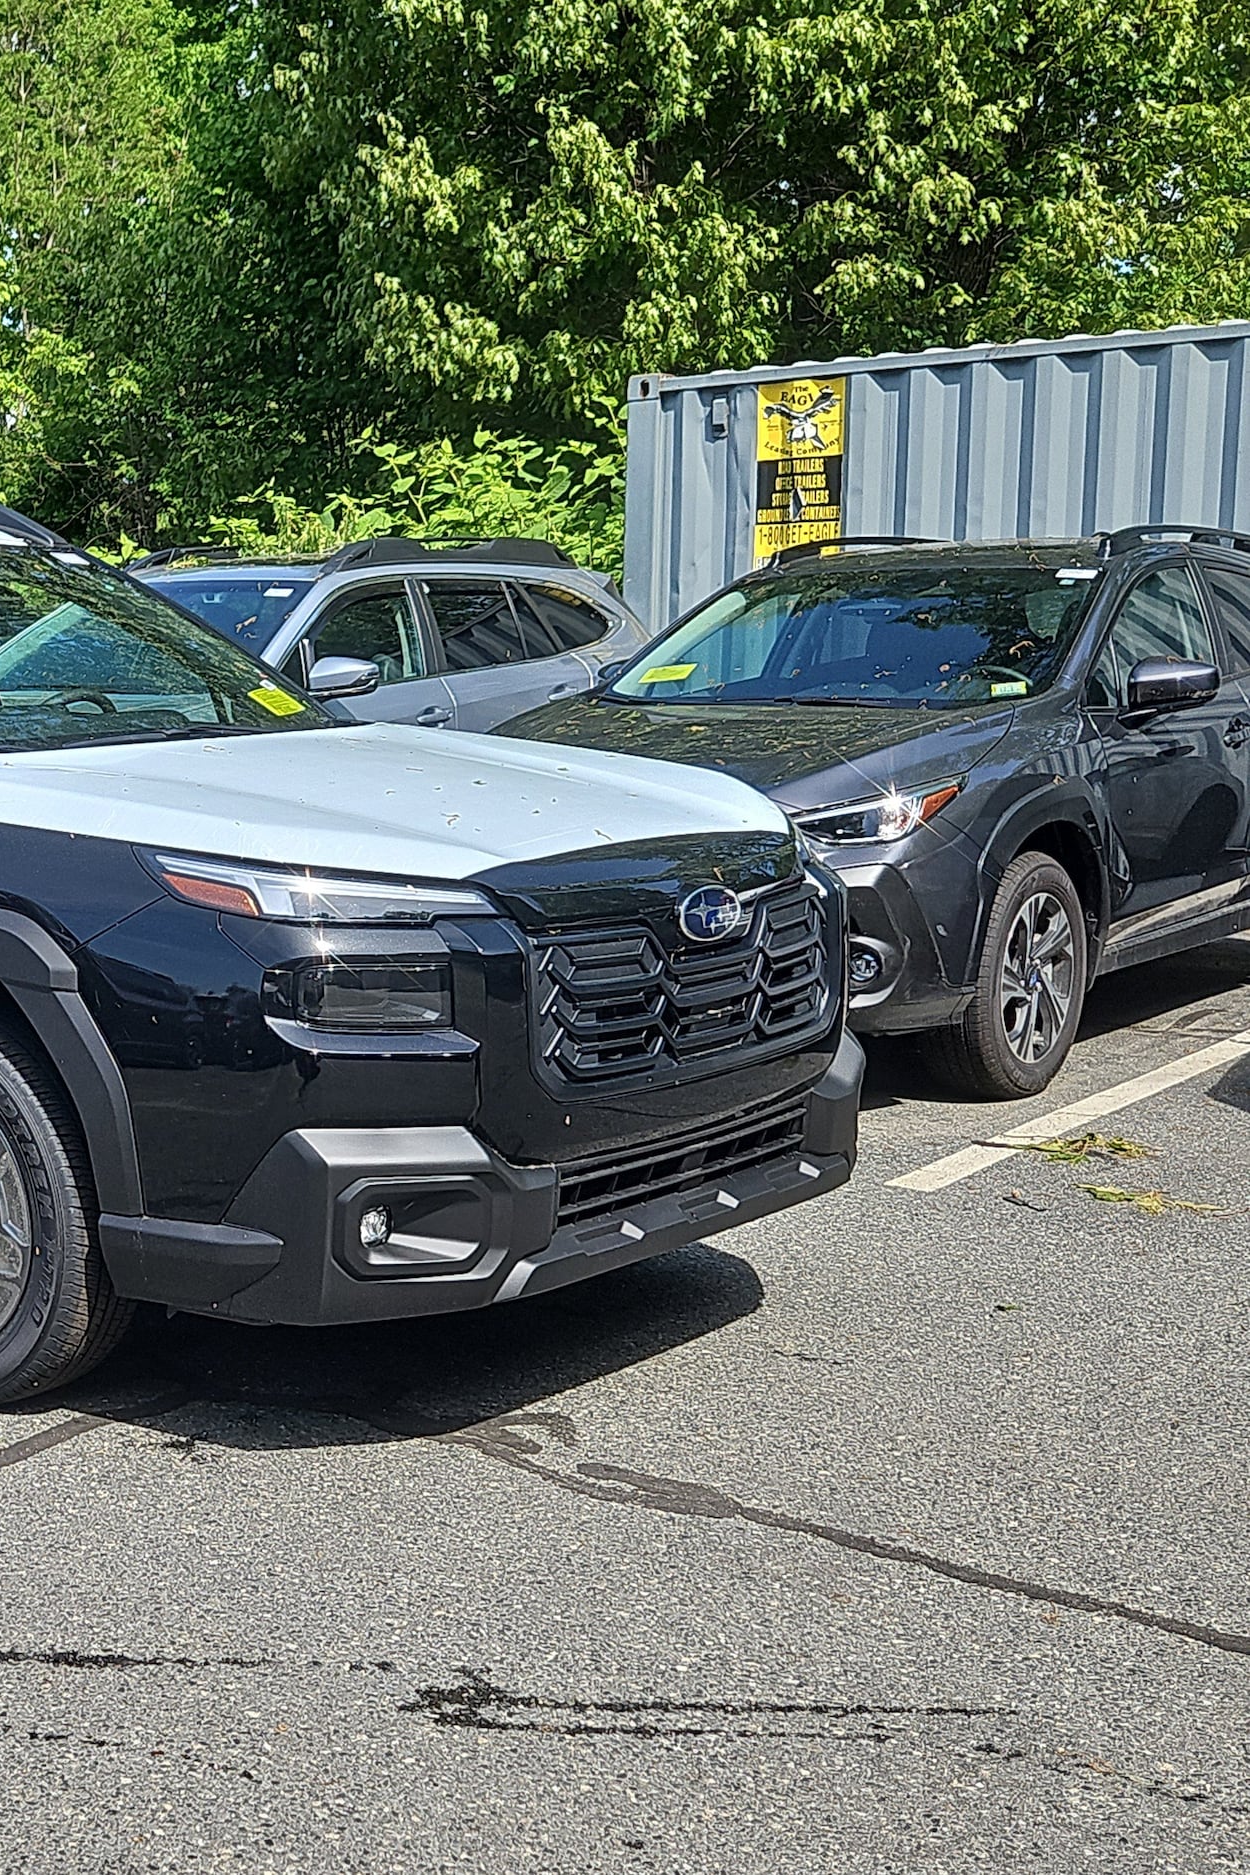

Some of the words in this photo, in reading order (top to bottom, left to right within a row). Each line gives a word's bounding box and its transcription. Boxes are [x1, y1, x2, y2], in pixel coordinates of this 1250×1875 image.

[781, 391, 813, 406] EAGL
[793, 458, 824, 473] TRAILERS
[794, 474, 827, 488] TRAILERS
